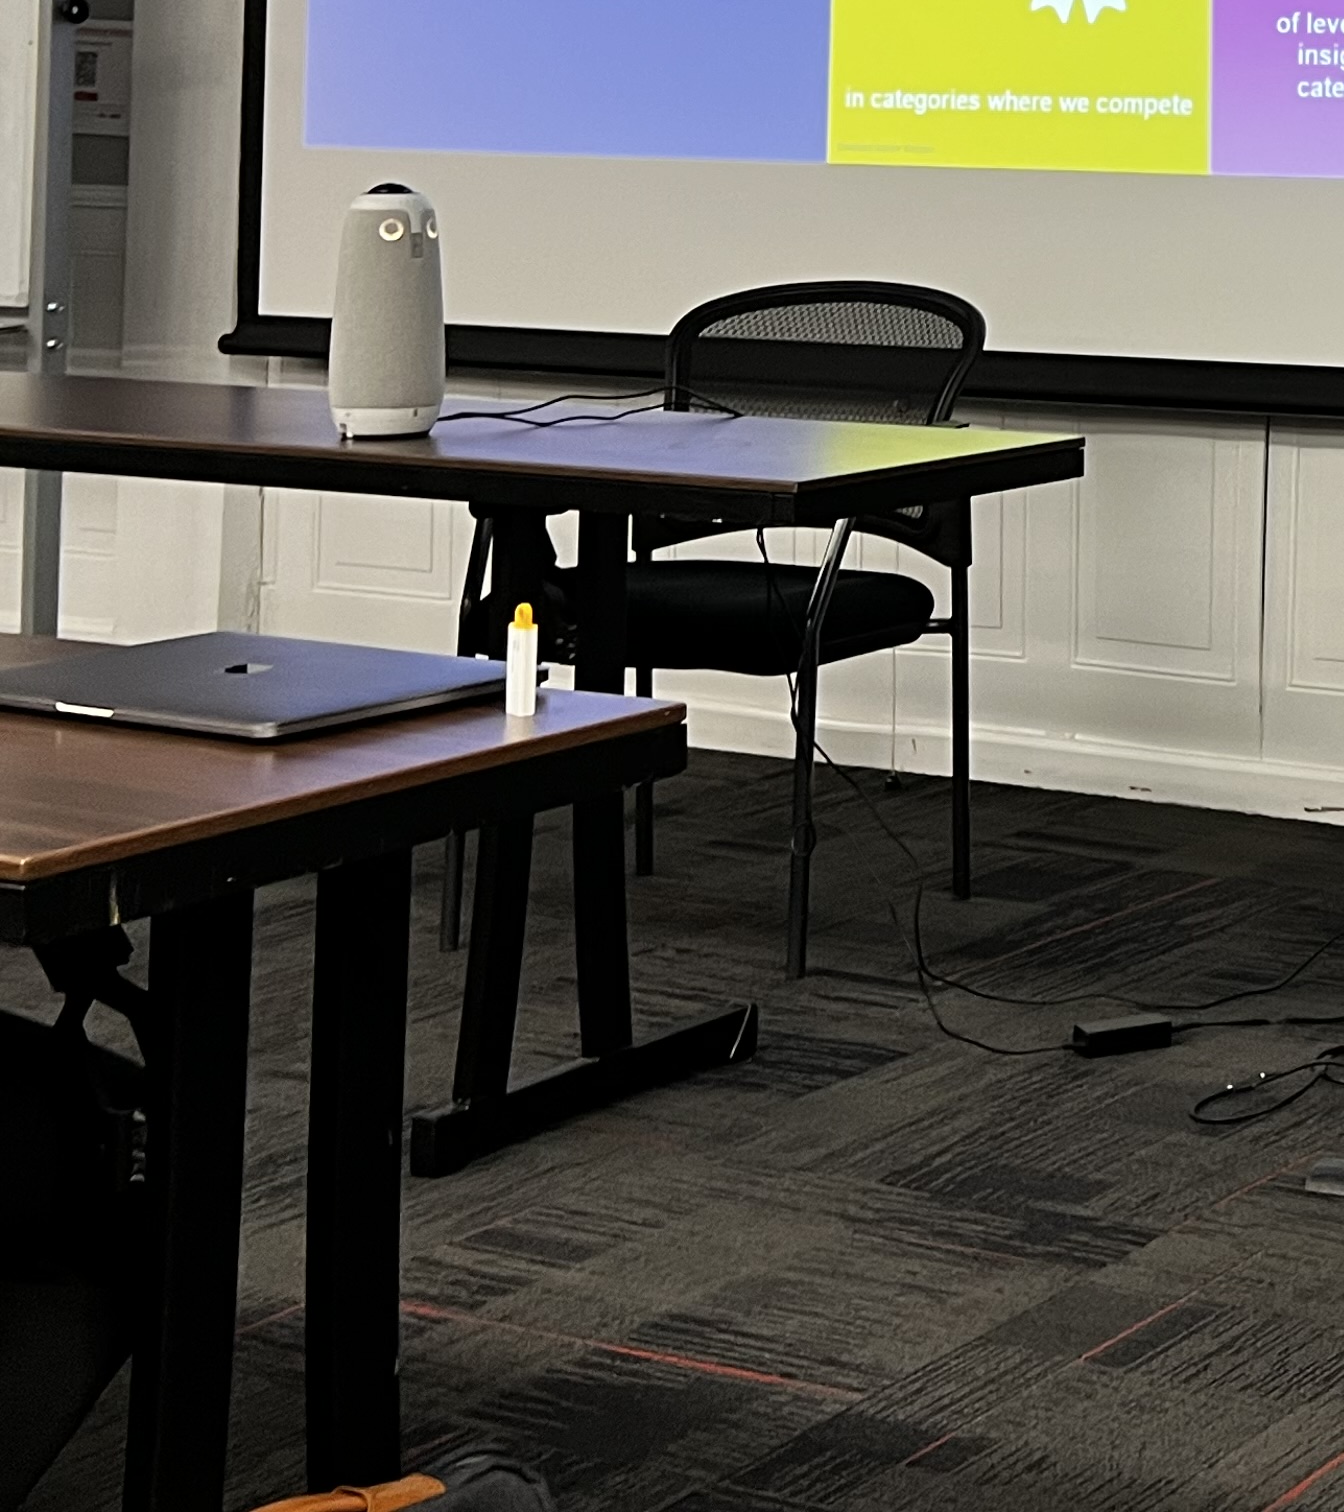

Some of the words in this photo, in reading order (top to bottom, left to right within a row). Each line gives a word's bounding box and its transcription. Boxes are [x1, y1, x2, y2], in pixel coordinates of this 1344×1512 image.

[1276, 12, 1299, 34] of
[845, 87, 864, 109] in
[870, 88, 981, 115] categories
[987, 90, 1052, 113] where
[1059, 95, 1089, 113] we
[1095, 93, 1193, 120] compete
